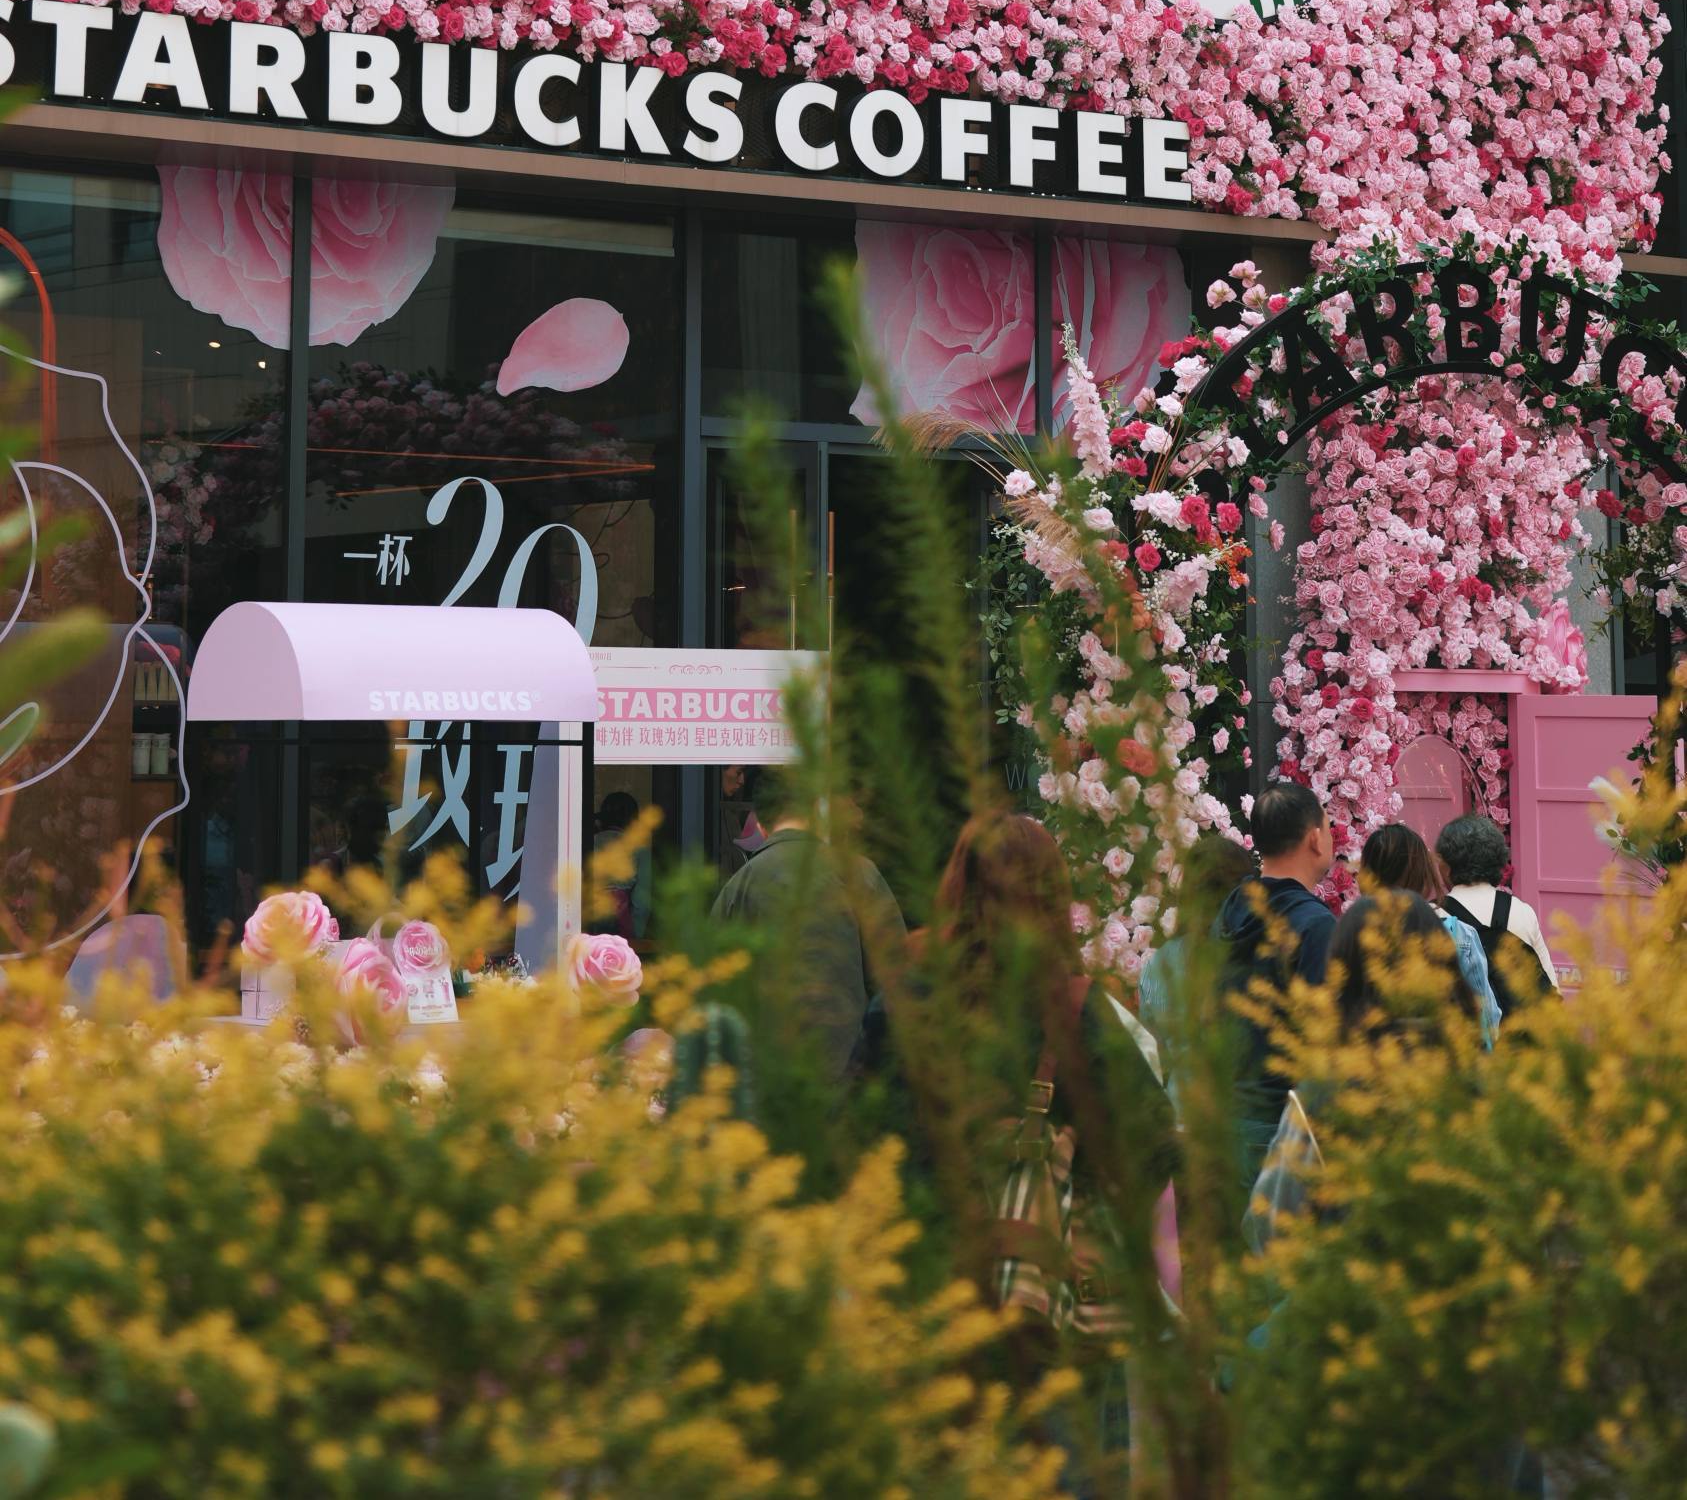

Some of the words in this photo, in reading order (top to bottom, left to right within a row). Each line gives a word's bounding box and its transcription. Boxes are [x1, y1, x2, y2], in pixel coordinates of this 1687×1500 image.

[775, 82, 1192, 202] COFFEE
[343, 534, 413, 586] 一杯
[639, 727, 689, 747] 玫瑰为约
